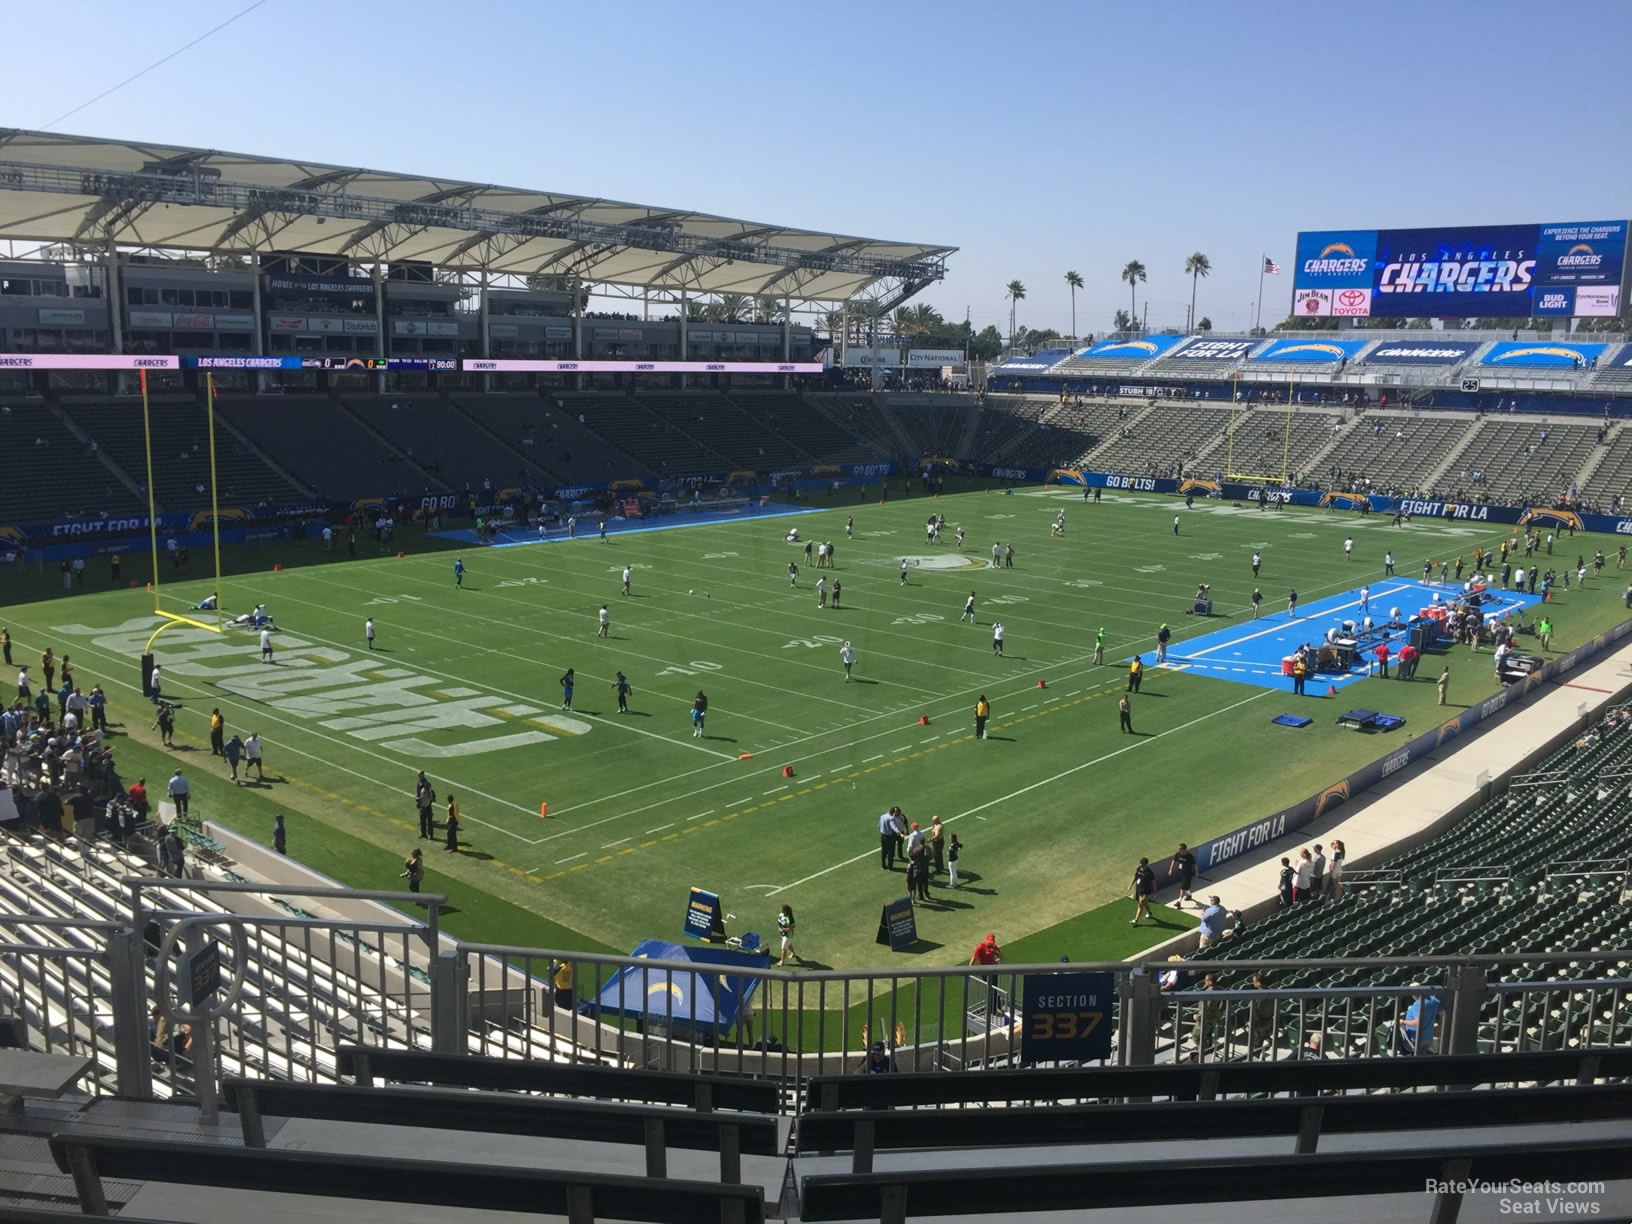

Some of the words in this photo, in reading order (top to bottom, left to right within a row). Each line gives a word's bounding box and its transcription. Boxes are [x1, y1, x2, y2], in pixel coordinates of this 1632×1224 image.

[1591, 225, 1621, 233] CHARGERS
[1398, 251, 1428, 262] LOS
[1442, 250, 1525, 261] ANGELES
[1557, 255, 1602, 266] CHARGERS
[1304, 258, 1368, 272] CHARGERS
[1379, 260, 1537, 293] CHARGERS
[272, 280, 293, 288] HOME
[1311, 290, 1328, 302] BEAM
[346, 322, 376, 330] StubHub
[1176, 349, 1218, 357] FOR
[1216, 350, 1245, 358] LA
[1376, 348, 1466, 358] CHARGERS
[0, 358, 32, 367] HARGERS
[134, 359, 168, 367] CHARGERS
[198, 358, 212, 368] LOS
[212, 358, 245, 368] ANGELES
[246, 358, 282, 368] CHARGERS
[1463, 380, 1477, 390] 25
[1106, 476, 1120, 487] GO
[1121, 477, 1155, 490] BLTS!
[1400, 500, 1441, 515] FIGHT
[1471, 506, 1487, 519] LA
[781, 634, 843, 649] 20
[655, 660, 723, 676] 10
[1209, 830, 1247, 866] FIGHT
[1247, 821, 1270, 849] FOR
[1271, 815, 1285, 839] LA
[691, 901, 712, 914] WARNING
[1038, 995, 1097, 1008] SECTION
[1032, 1012, 1104, 1039] 337
